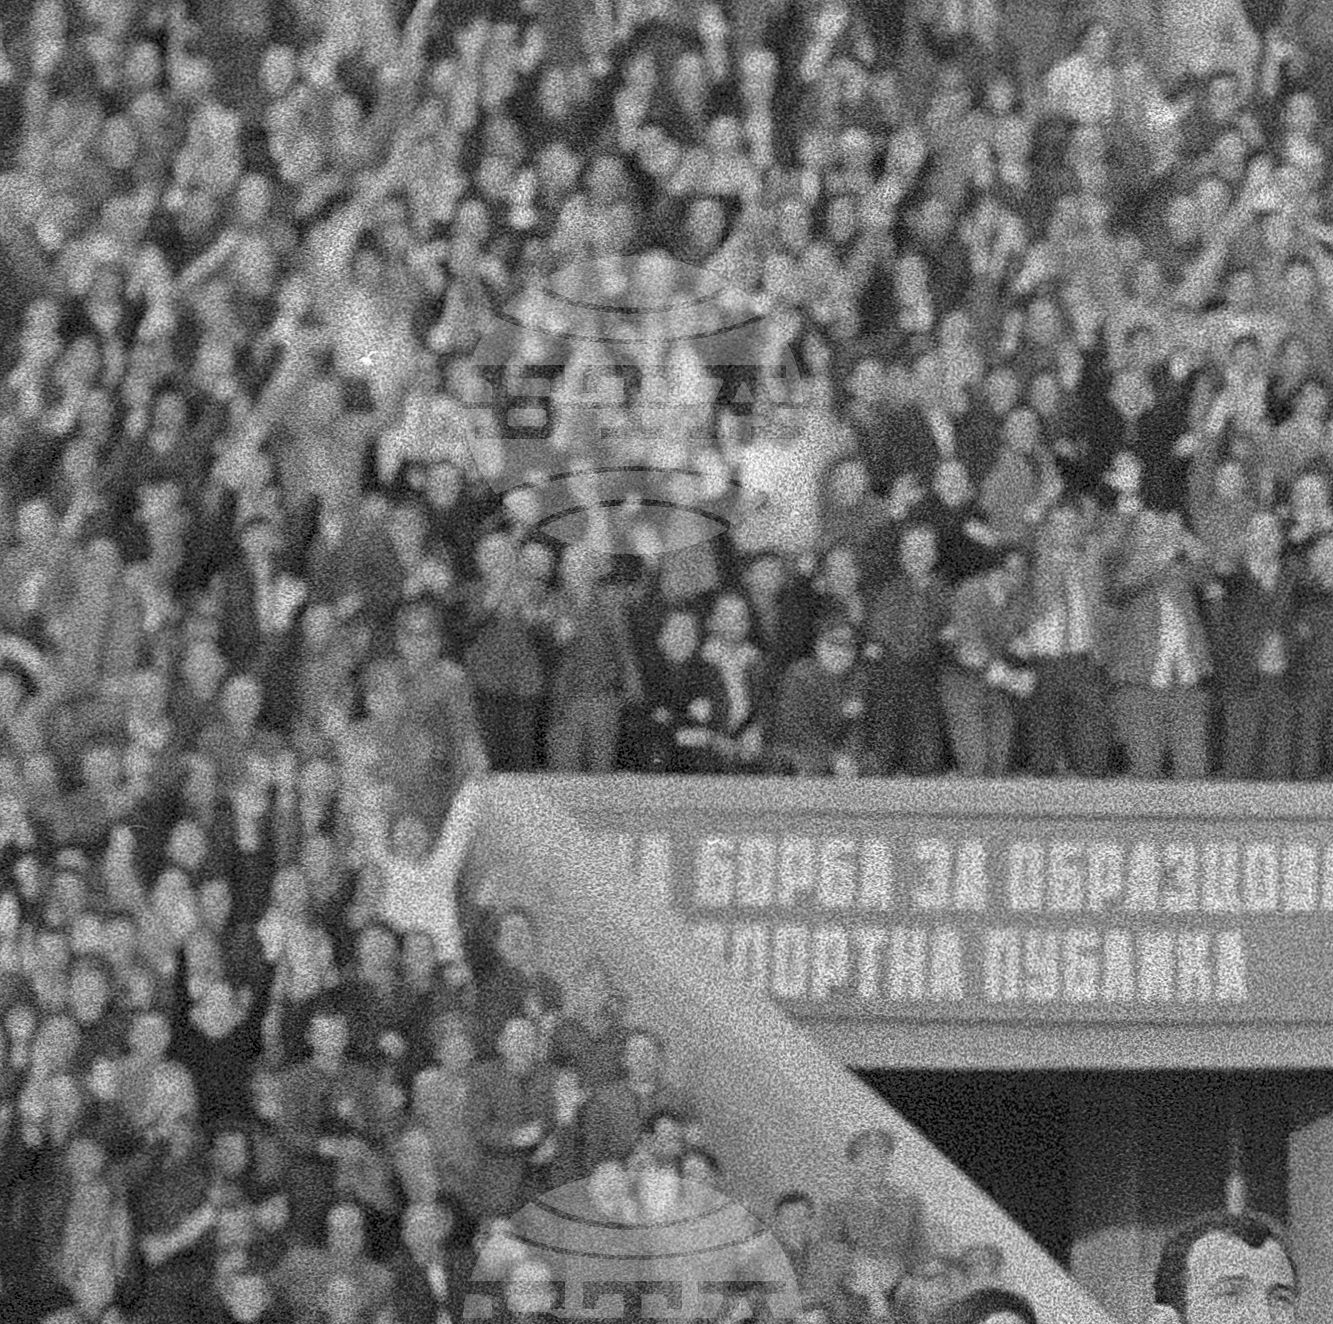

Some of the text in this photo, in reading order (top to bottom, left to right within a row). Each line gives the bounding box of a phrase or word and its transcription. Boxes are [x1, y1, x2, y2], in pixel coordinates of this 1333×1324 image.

[695, 834, 894, 910] БОРБА
[912, 836, 986, 912] ЗА
[983, 927, 1249, 1003] ПУБЛИКА
